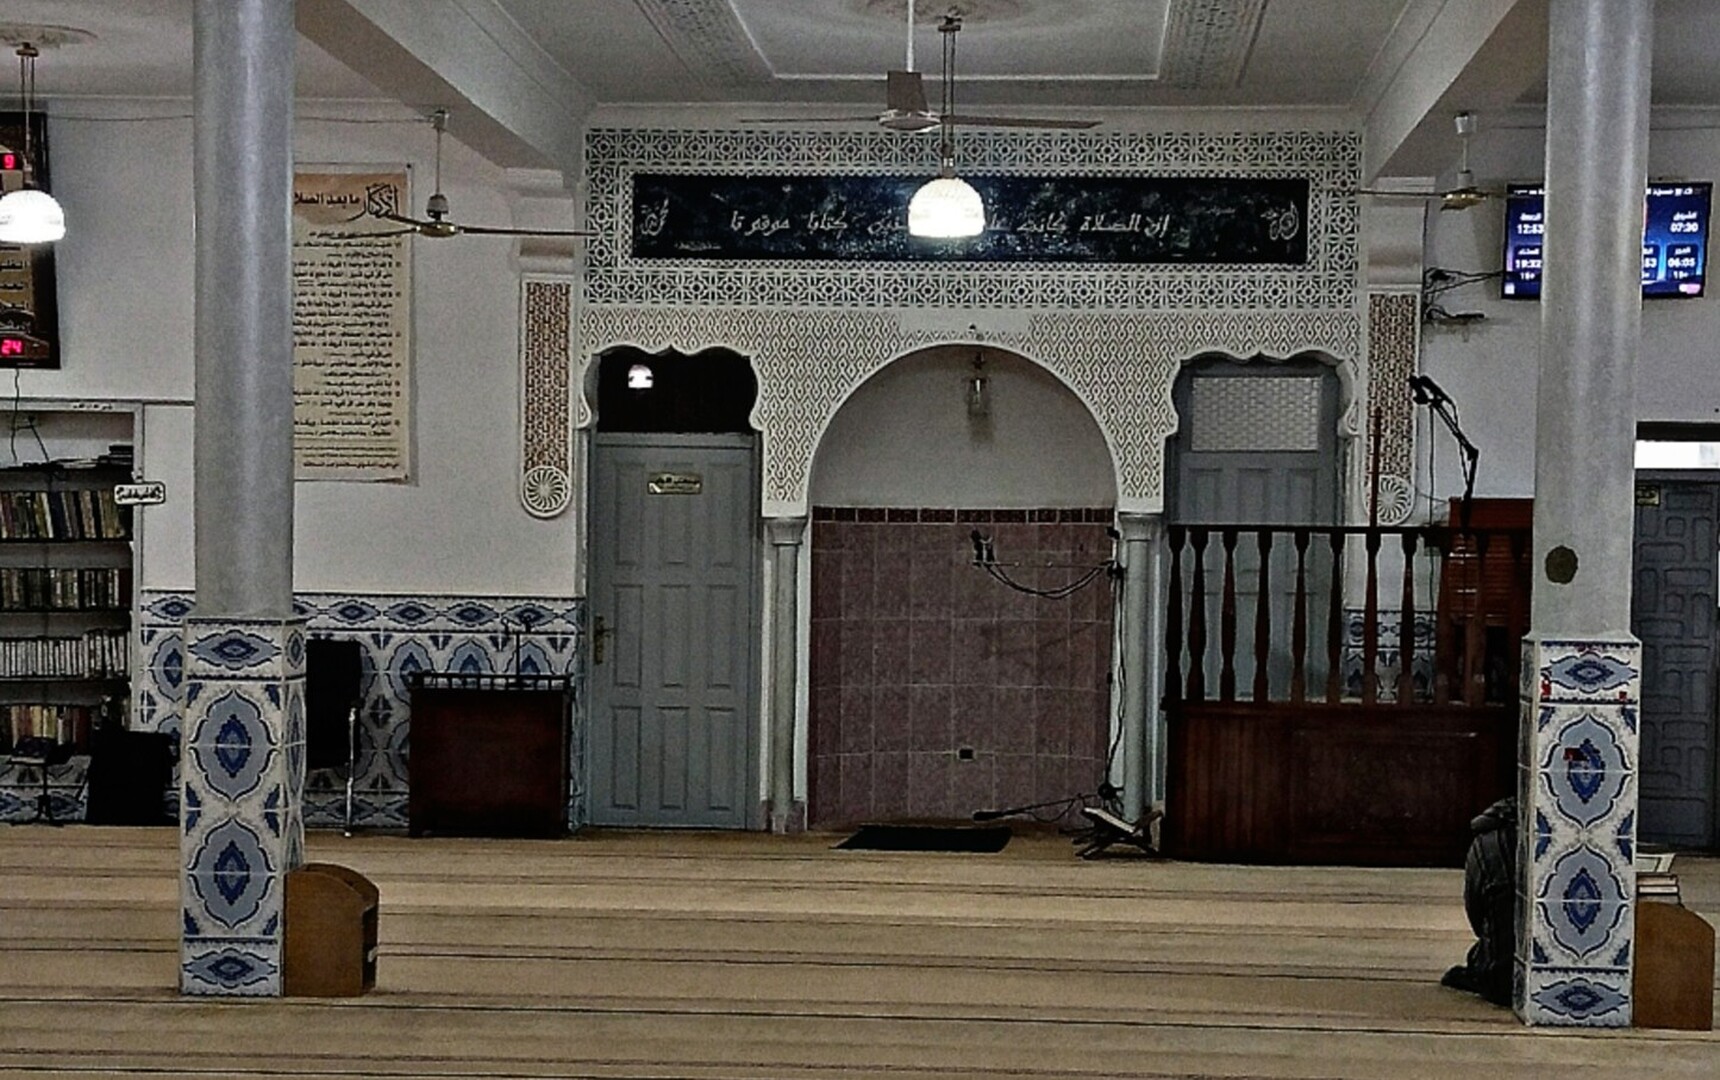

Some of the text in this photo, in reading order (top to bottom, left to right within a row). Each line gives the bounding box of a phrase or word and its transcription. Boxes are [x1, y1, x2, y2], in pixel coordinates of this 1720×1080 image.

[293, 190, 324, 205] الصلا
[326, 193, 348, 209] بعد
[1080, 212, 1142, 232] الصلاة
